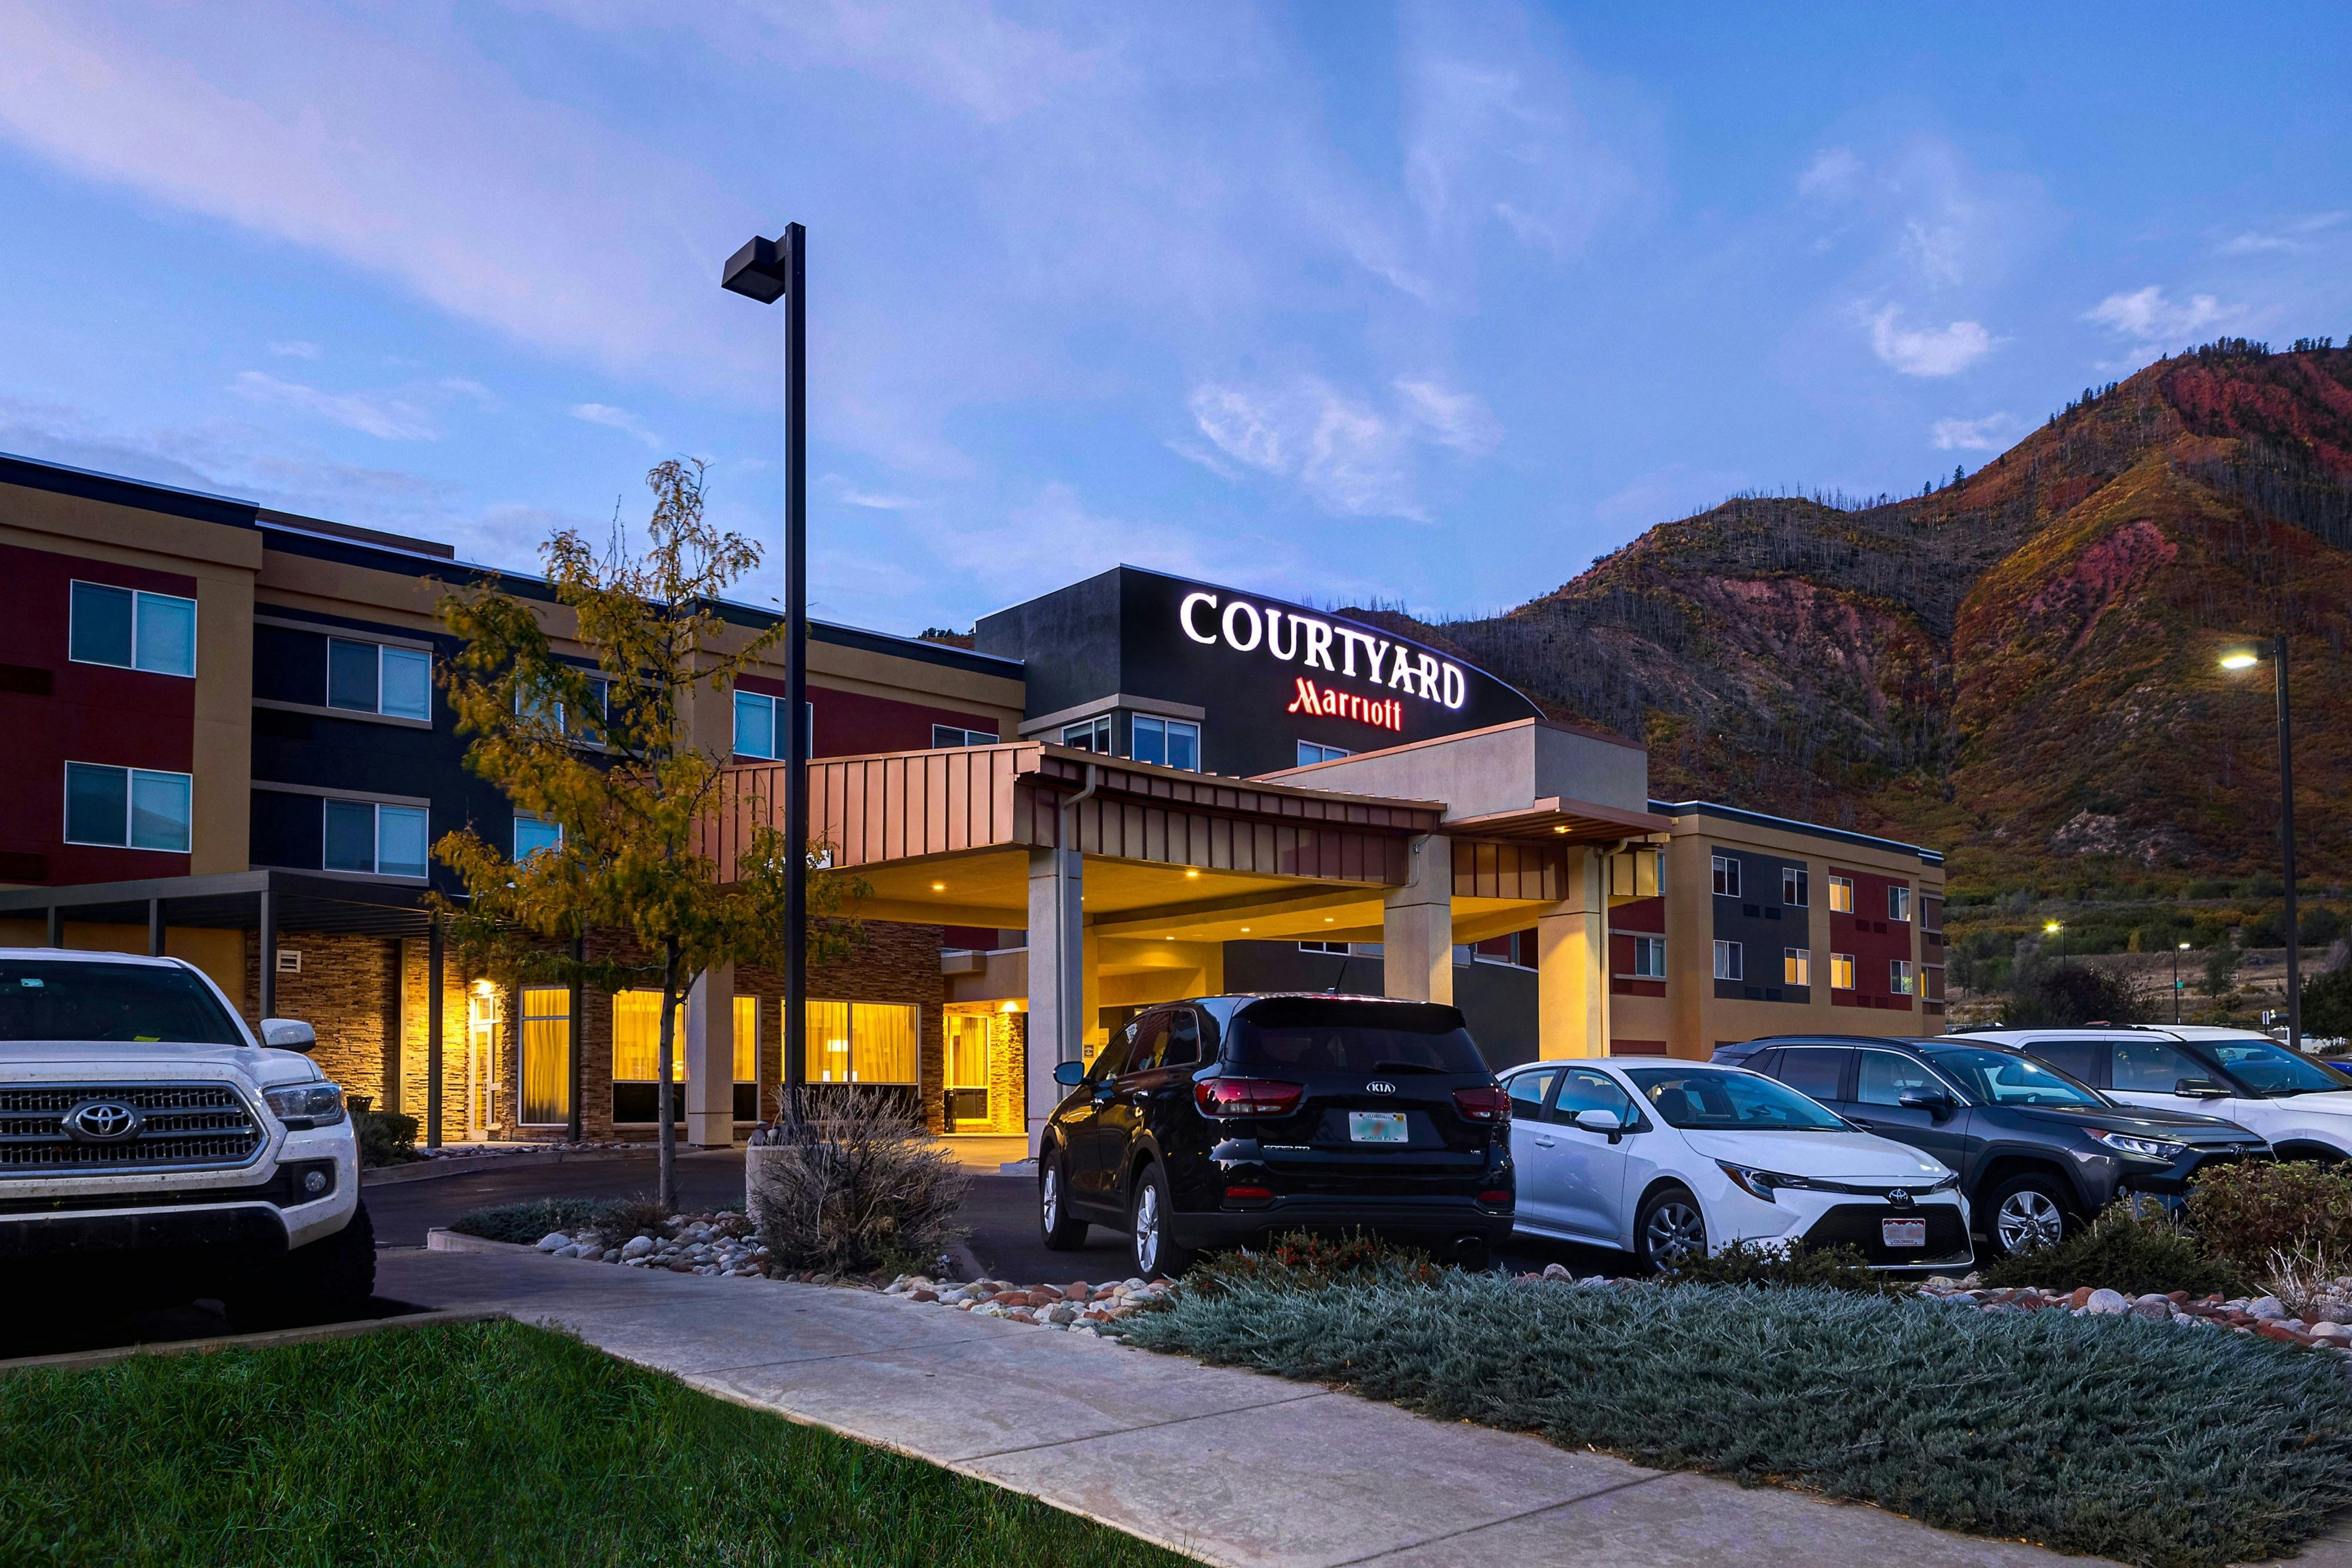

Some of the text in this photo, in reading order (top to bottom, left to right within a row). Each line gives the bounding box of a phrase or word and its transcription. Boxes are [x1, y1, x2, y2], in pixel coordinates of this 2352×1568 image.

[1179, 592, 1465, 710] COURTYARD
[1288, 677, 1402, 731] Marriott
[1372, 1084, 1391, 1092] KIA
